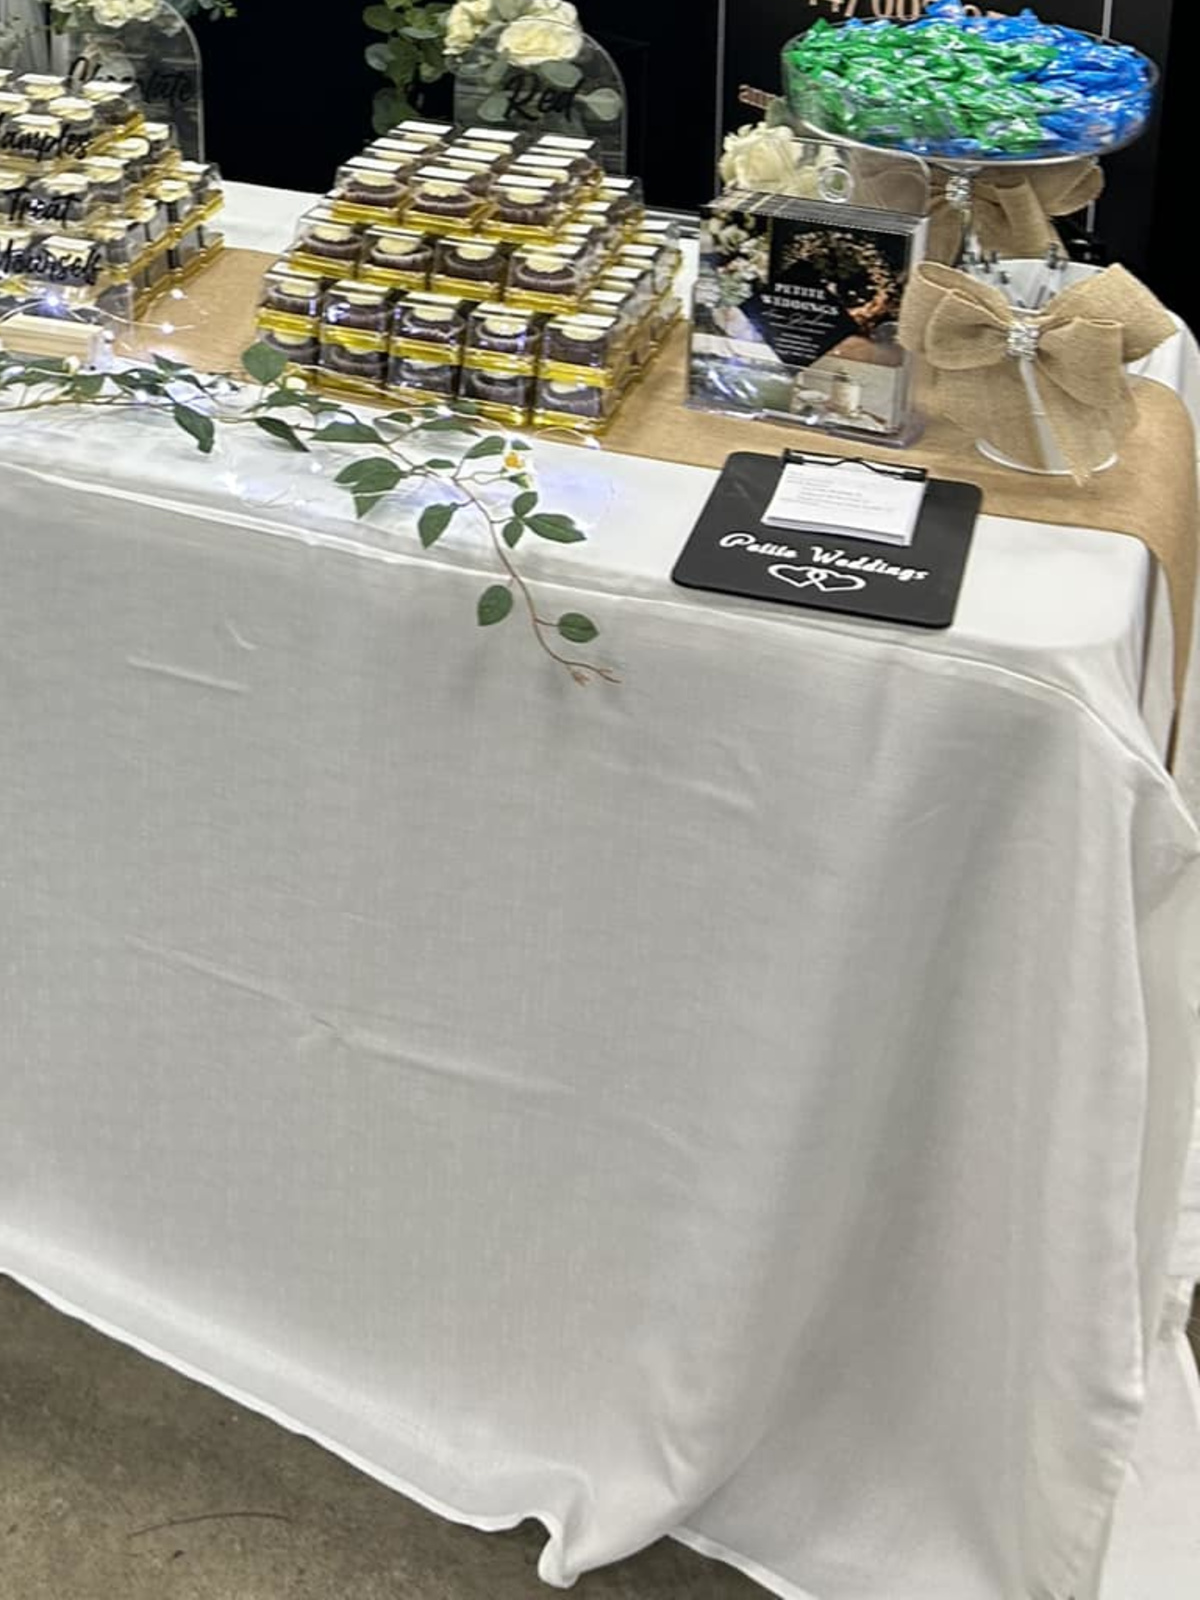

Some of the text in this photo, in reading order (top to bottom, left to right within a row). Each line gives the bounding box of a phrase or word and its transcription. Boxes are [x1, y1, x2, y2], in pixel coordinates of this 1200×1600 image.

[505, 72, 585, 122] Red
[0, 188, 87, 228] Treat
[760, 293, 840, 315] WEDDINGS
[775, 283, 827, 300] PETITE
[719, 532, 929, 581] Petite Weddings
